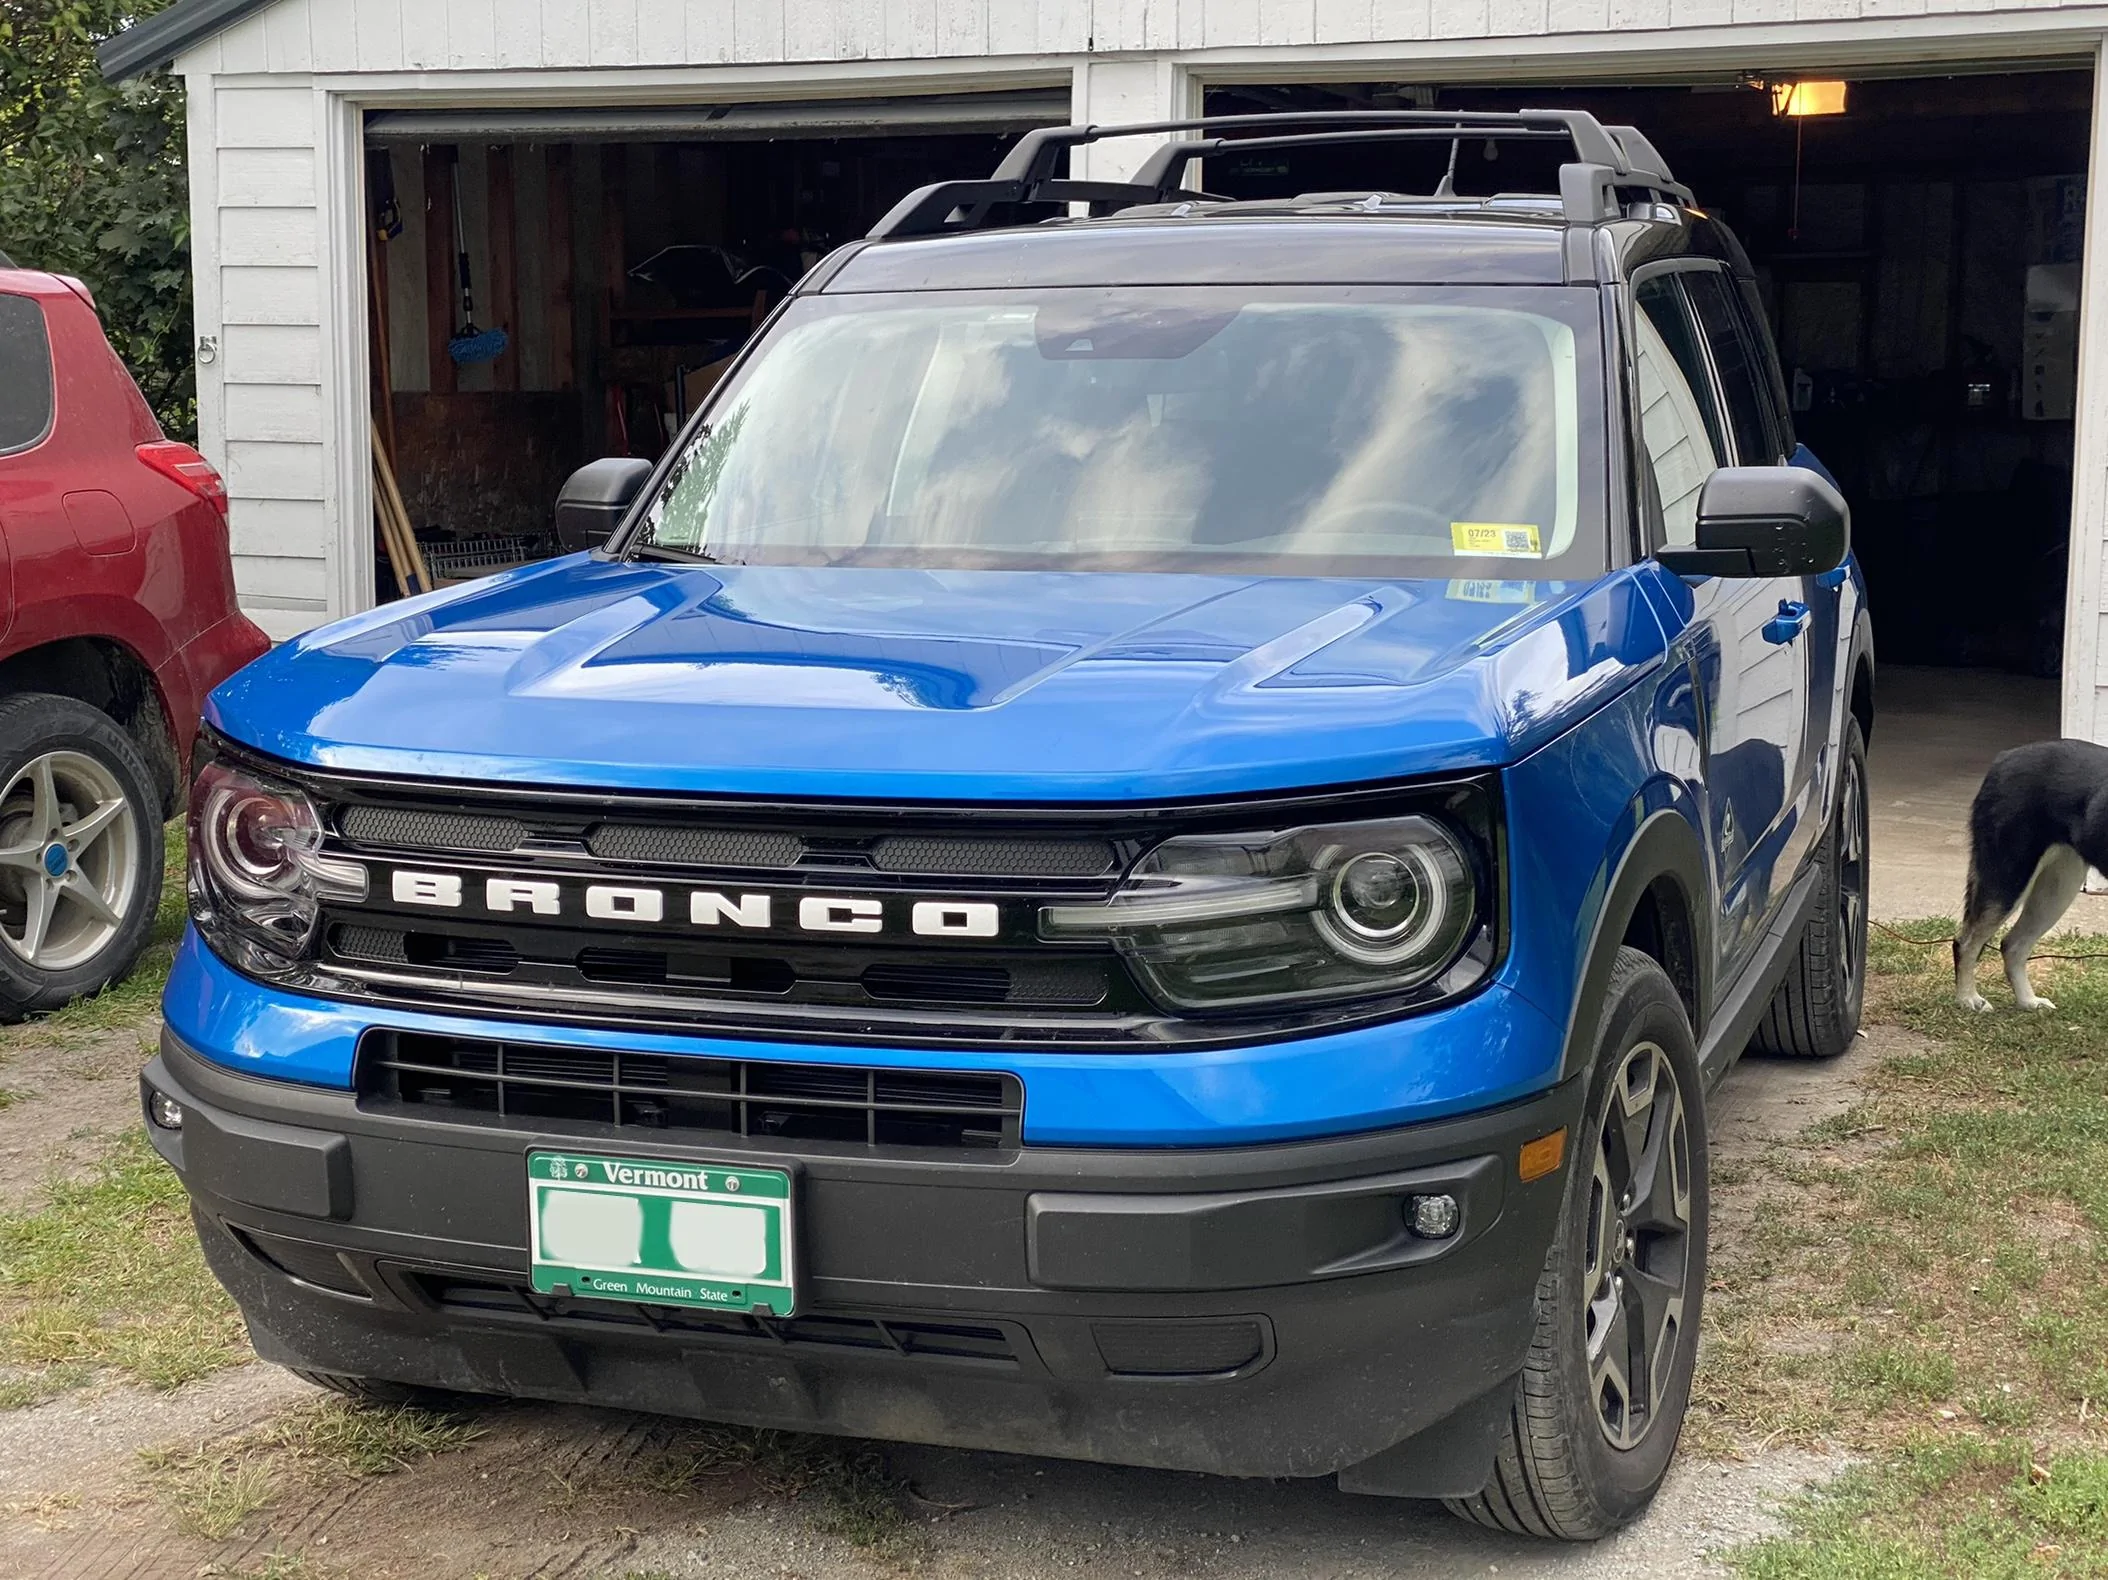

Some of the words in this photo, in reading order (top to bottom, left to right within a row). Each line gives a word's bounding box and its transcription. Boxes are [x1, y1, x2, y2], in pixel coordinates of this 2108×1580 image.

[1468, 528, 1497, 538] 07/23
[391, 869, 1000, 937] BRONCO
[603, 1161, 708, 1190] Vermont
[593, 1278, 627, 1292] Green
[636, 1282, 692, 1298] Mountain
[699, 1288, 728, 1302] State
